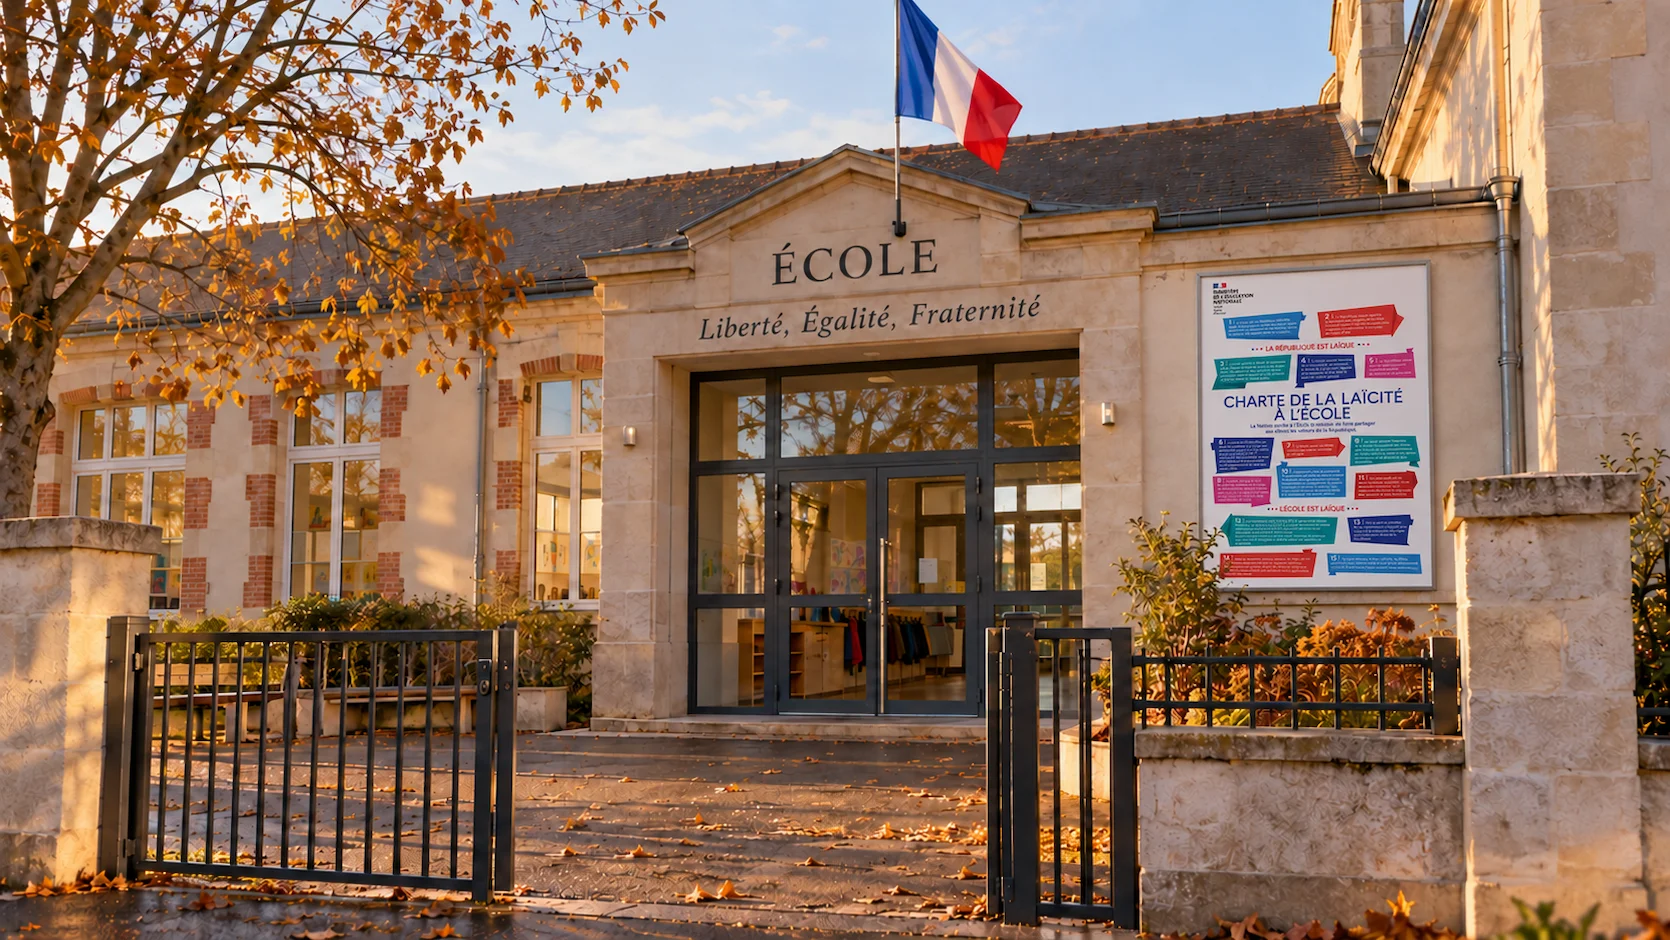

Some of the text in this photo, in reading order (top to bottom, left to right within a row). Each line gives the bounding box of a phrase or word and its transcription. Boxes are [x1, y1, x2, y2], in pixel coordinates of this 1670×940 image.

[771, 238, 939, 286] ÉCOLE
[698, 293, 1041, 341] Liberté, Égalité, Fraternité
[1275, 343, 1315, 351] RÉPUBLIQUE
[1317, 342, 1328, 350] EST
[1330, 341, 1355, 350] LAÏQUE
[1223, 387, 1403, 408] CHARTE DE LA LAÏCITÉ
[1274, 405, 1351, 421] À L'ÉCOLE
[1320, 503, 1345, 512] LAÏQUE
